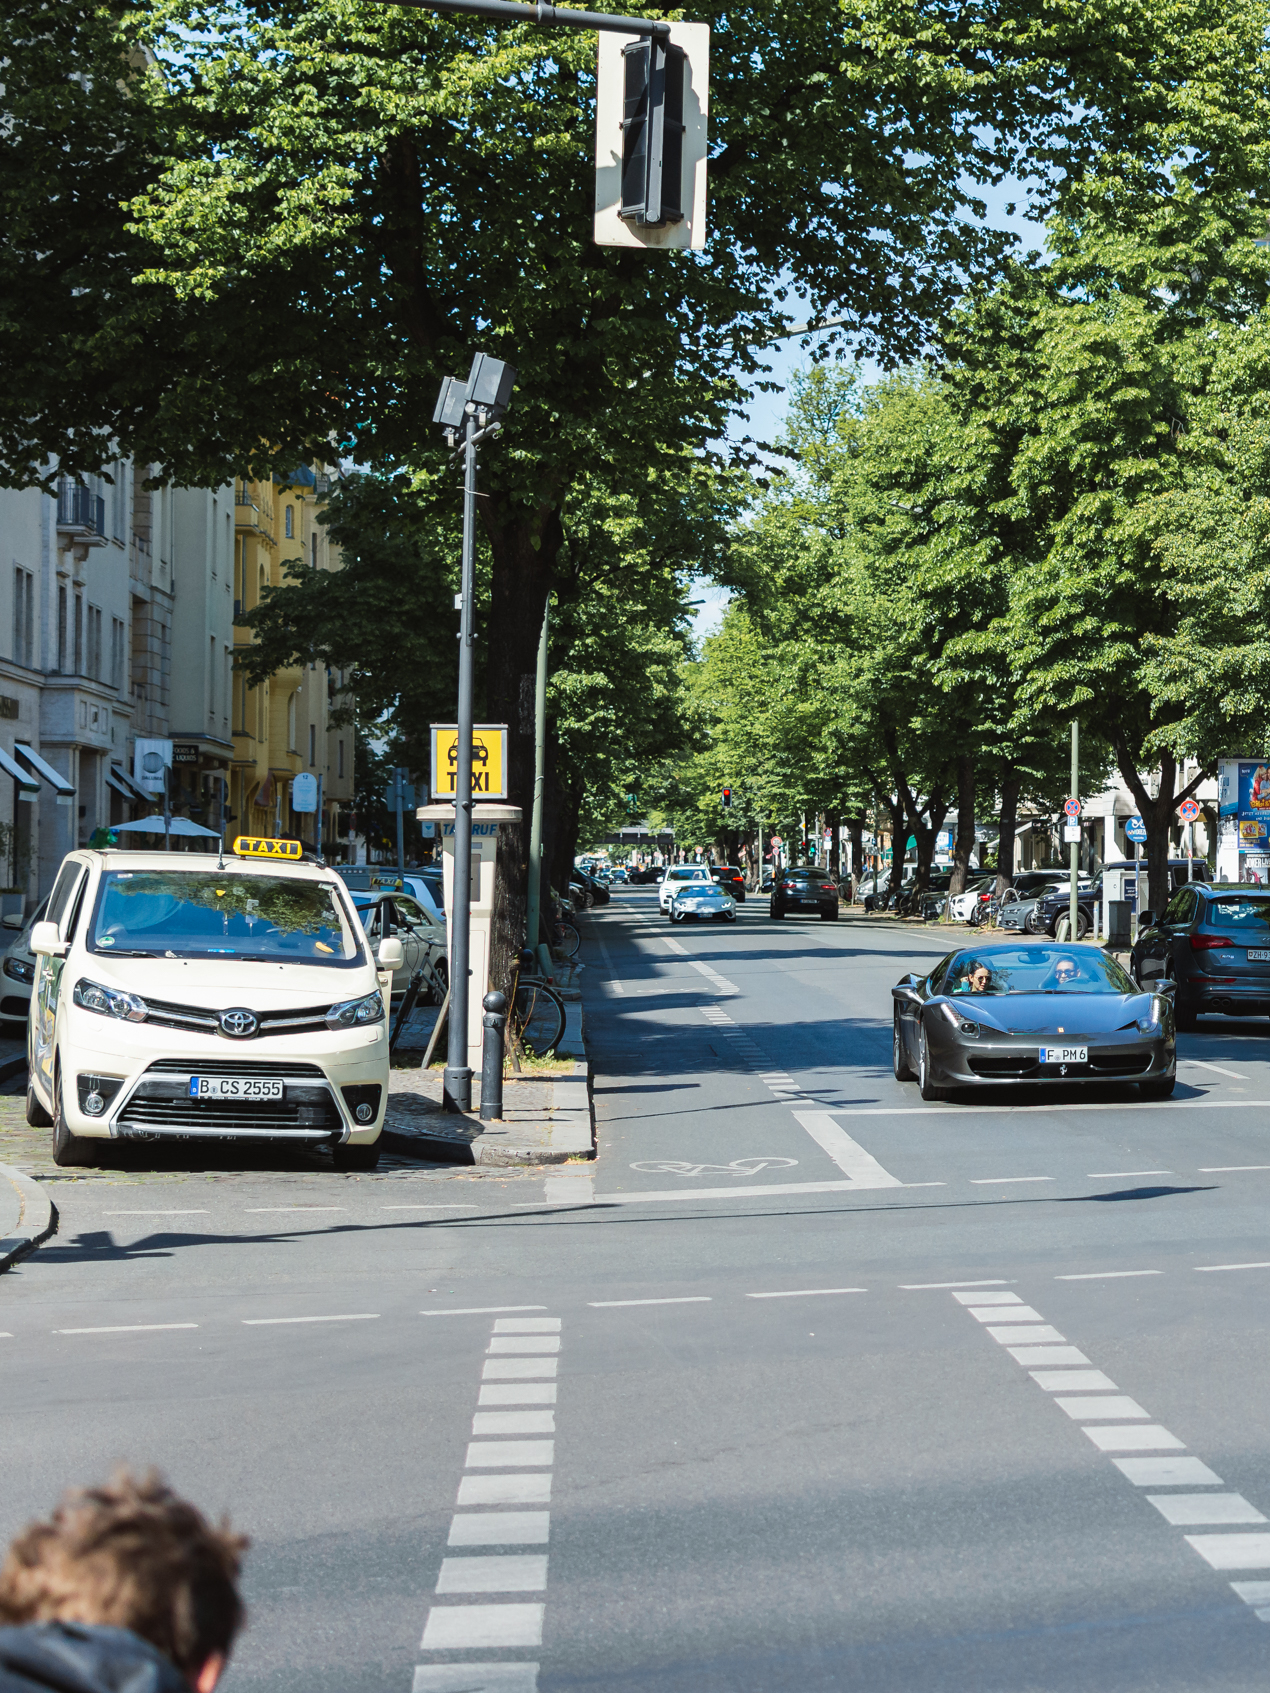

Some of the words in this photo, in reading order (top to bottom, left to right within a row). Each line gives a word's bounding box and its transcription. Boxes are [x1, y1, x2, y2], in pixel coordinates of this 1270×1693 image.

[447, 772, 489, 791] TXI
[443, 824, 498, 835] TARUF
[247, 841, 291, 853] TAXI
[1047, 1049, 1055, 1060] F
[1062, 1049, 1077, 1060] PM
[1079, 1049, 1086, 1060] 6
[200, 1080, 209, 1093] B
[220, 1080, 240, 1094] CS
[243, 1081, 281, 1096] 2555
